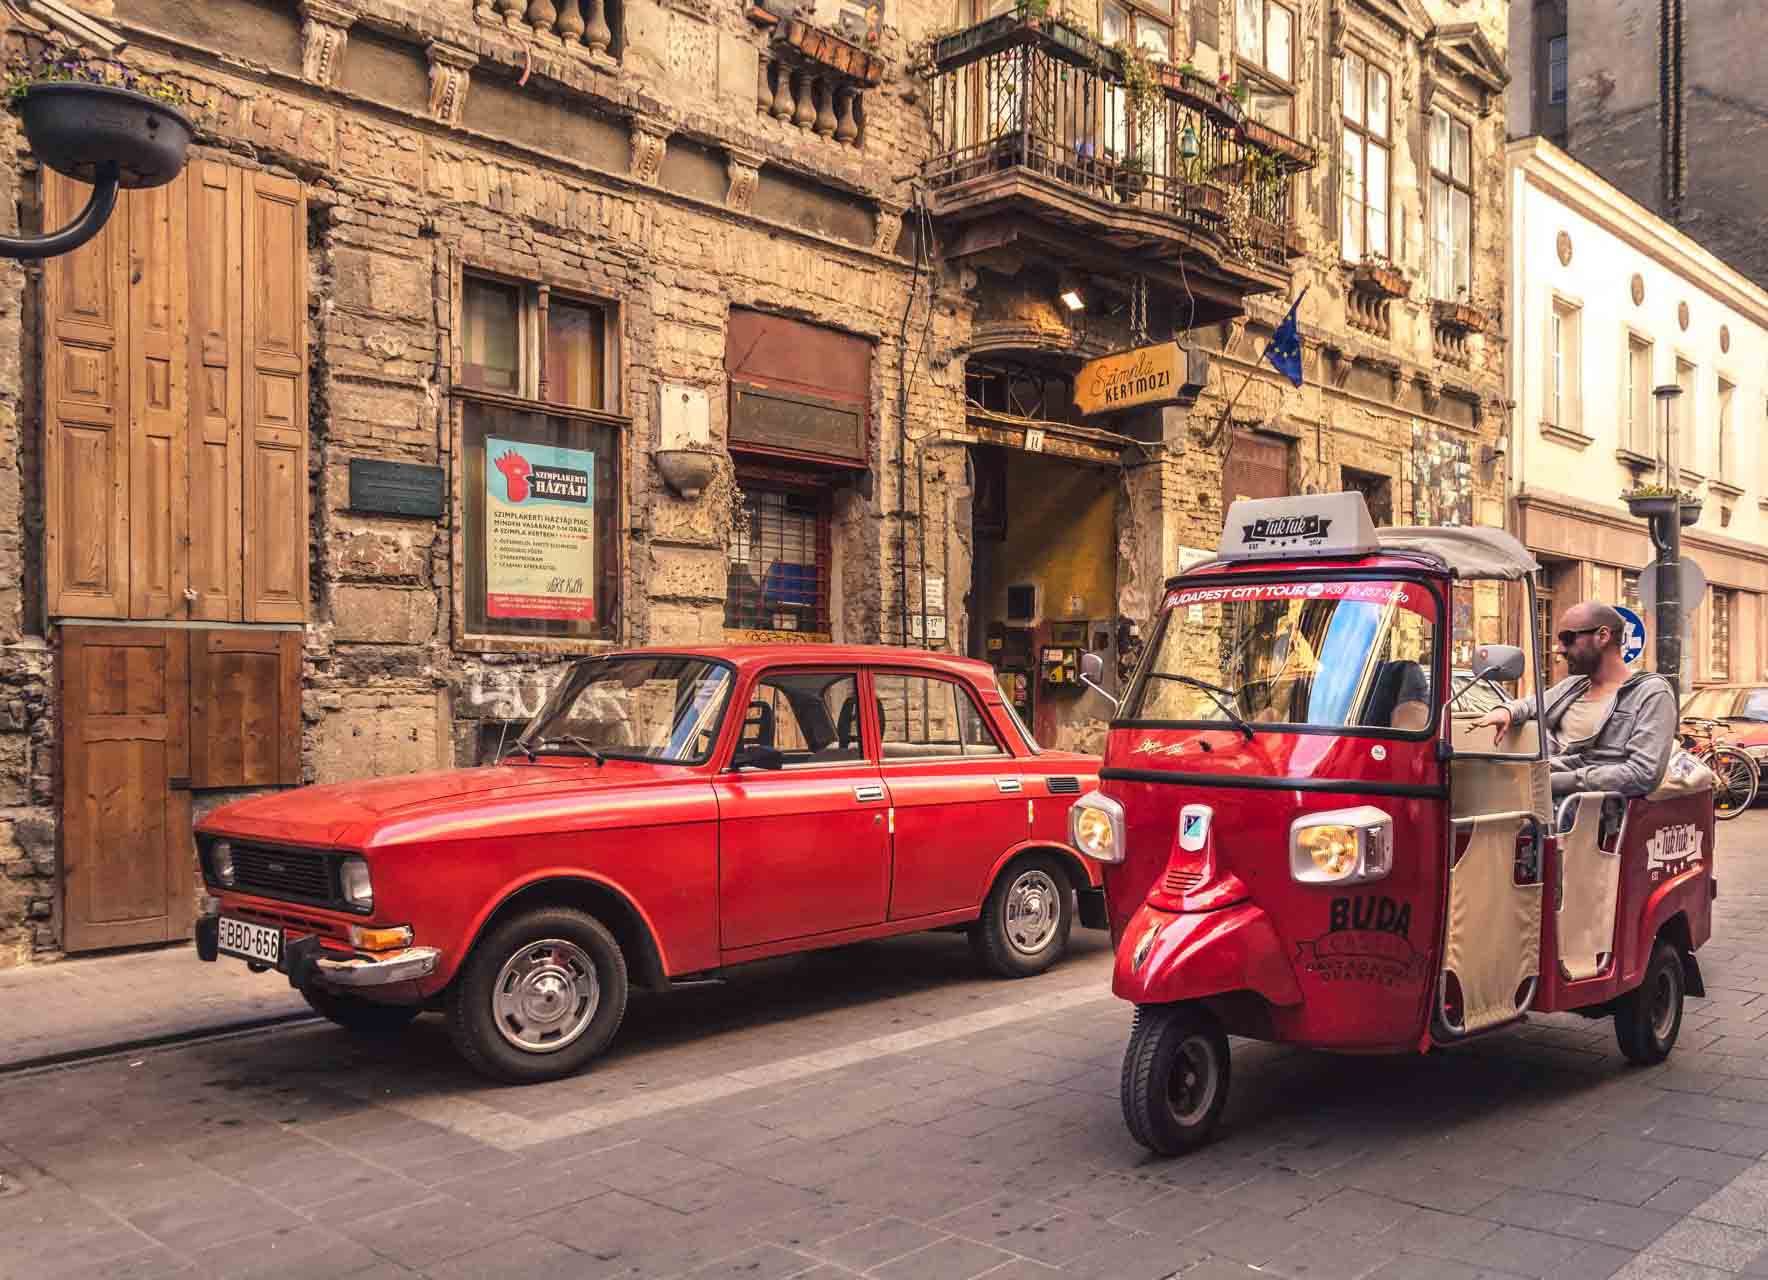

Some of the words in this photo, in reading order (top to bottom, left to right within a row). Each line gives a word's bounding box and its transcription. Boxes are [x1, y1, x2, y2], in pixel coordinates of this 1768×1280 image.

[1105, 370, 1170, 404] KERTMOZI
[535, 471, 587, 484] SZIMPLAKERTI
[535, 480, 587, 497] HÁZTÁJI
[494, 511, 543, 521] SZIMPLAKERTI
[494, 519, 521, 527] MINDEN
[1265, 515, 1307, 535] TukTuk
[1167, 588, 1232, 608] BUDAPEST
[1231, 587, 1265, 598] CITY
[1265, 582, 1306, 597] TOUR
[1329, 896, 1411, 939] BUDA
